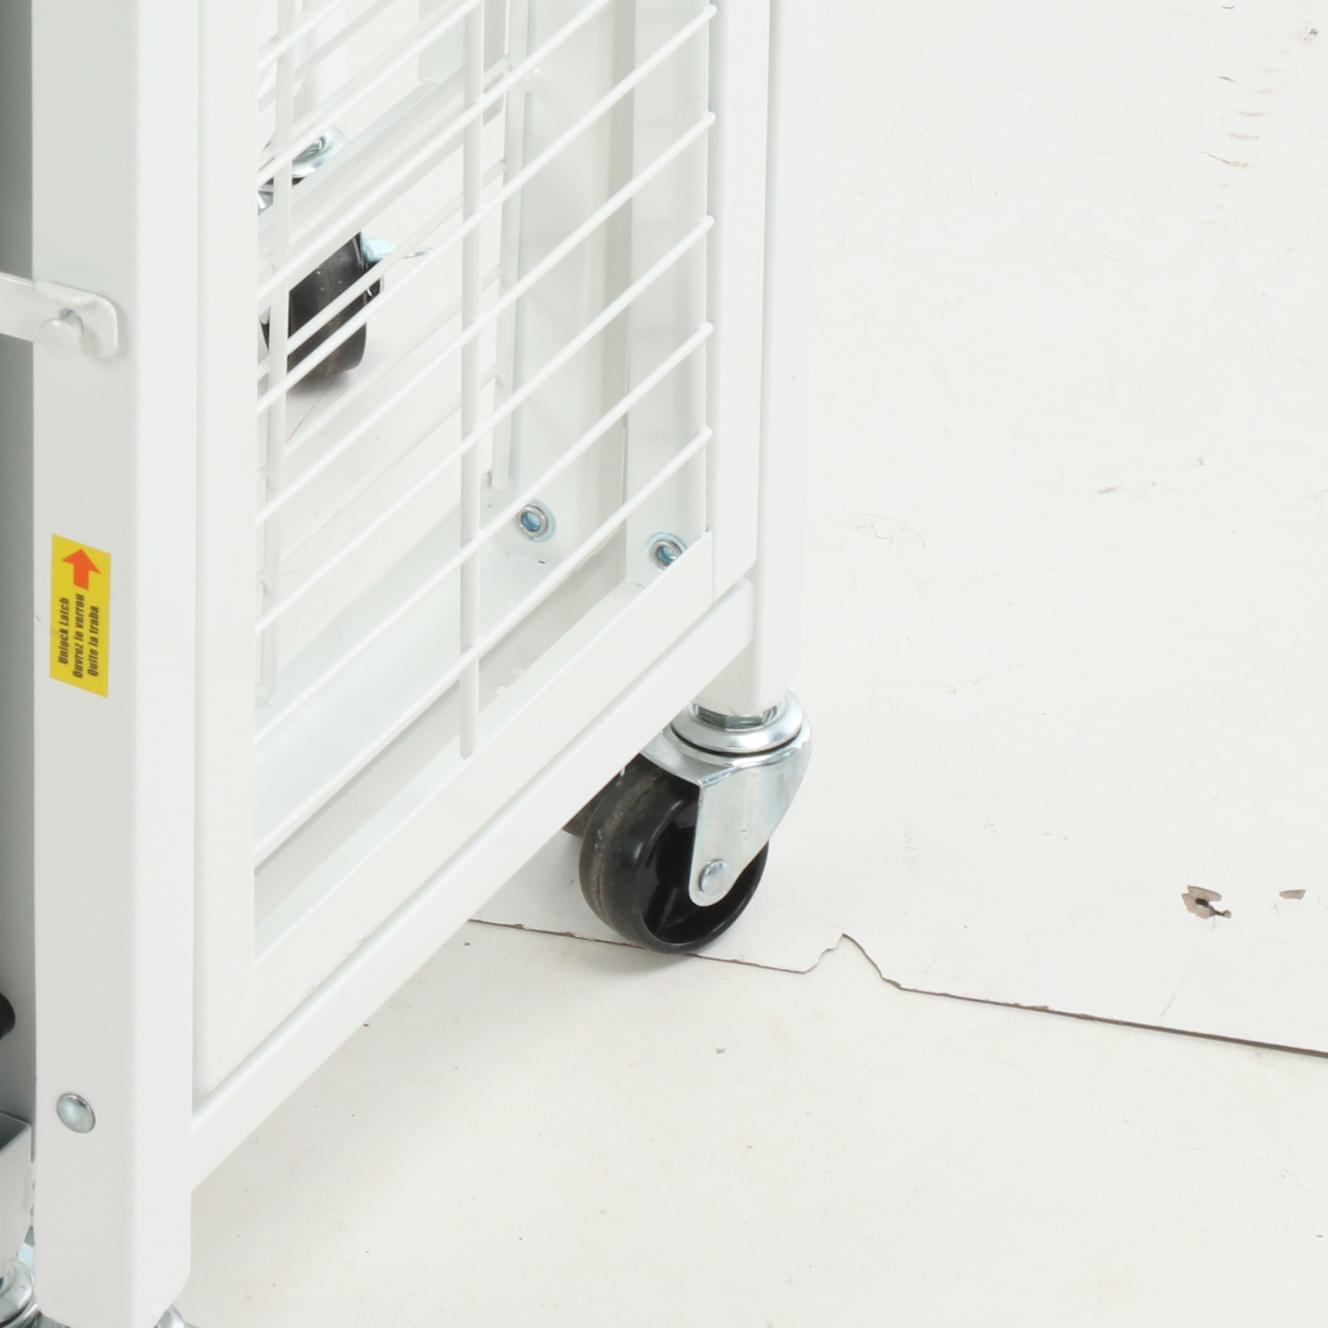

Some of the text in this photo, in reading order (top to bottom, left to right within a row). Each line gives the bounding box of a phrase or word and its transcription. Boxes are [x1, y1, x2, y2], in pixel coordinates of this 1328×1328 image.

[58, 597, 70, 665] Unlock Latch
[72, 593, 85, 679] Ouvrez le verrou
[87, 605, 99, 677] Quite la traba
